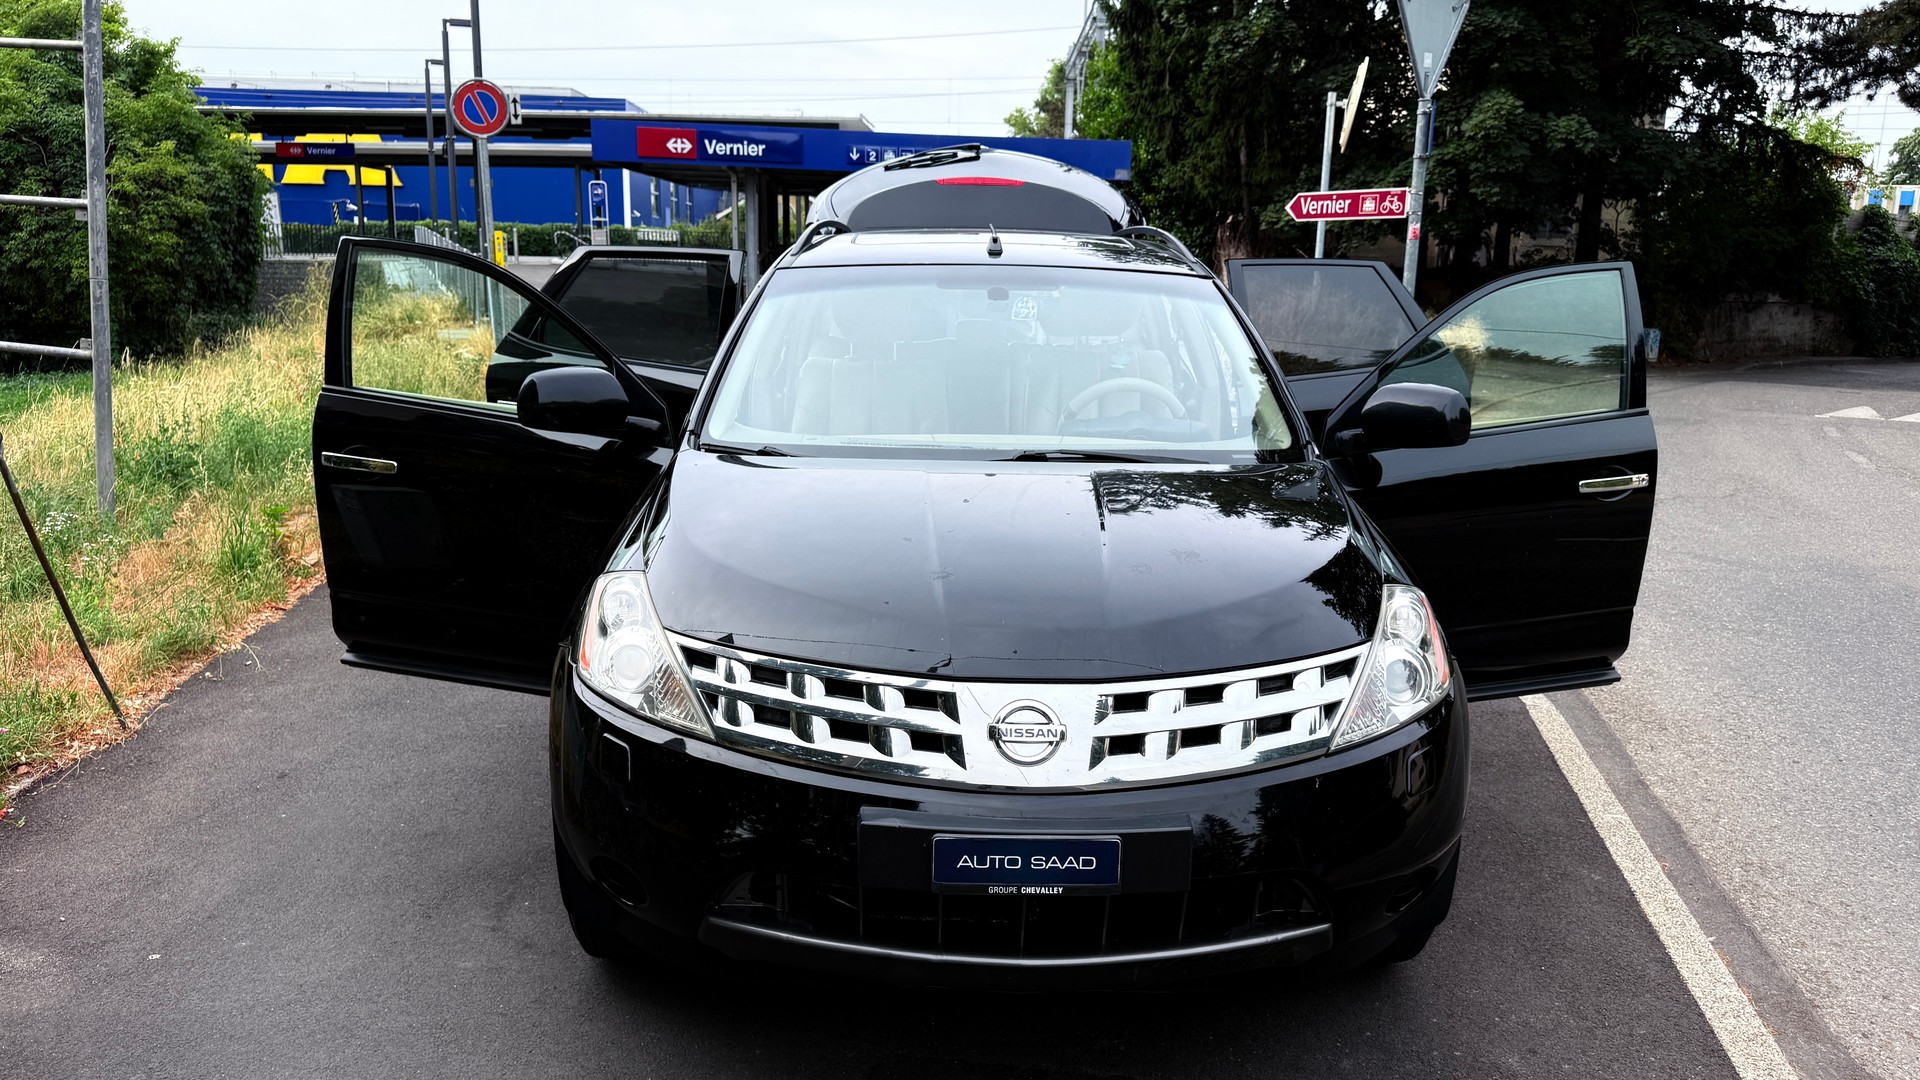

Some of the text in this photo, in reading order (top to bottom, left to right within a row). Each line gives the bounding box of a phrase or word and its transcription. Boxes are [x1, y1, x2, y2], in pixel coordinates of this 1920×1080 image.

[306, 146, 336, 156] Vernier
[704, 138, 766, 157] Vernier
[869, 151, 877, 161] 2
[1300, 195, 1352, 215] Vernier
[997, 728, 1058, 739] NISSAN
[957, 855, 1096, 870] AUTO SAAD
[988, 886, 1063, 894] GROUPE CHEVALLEY
